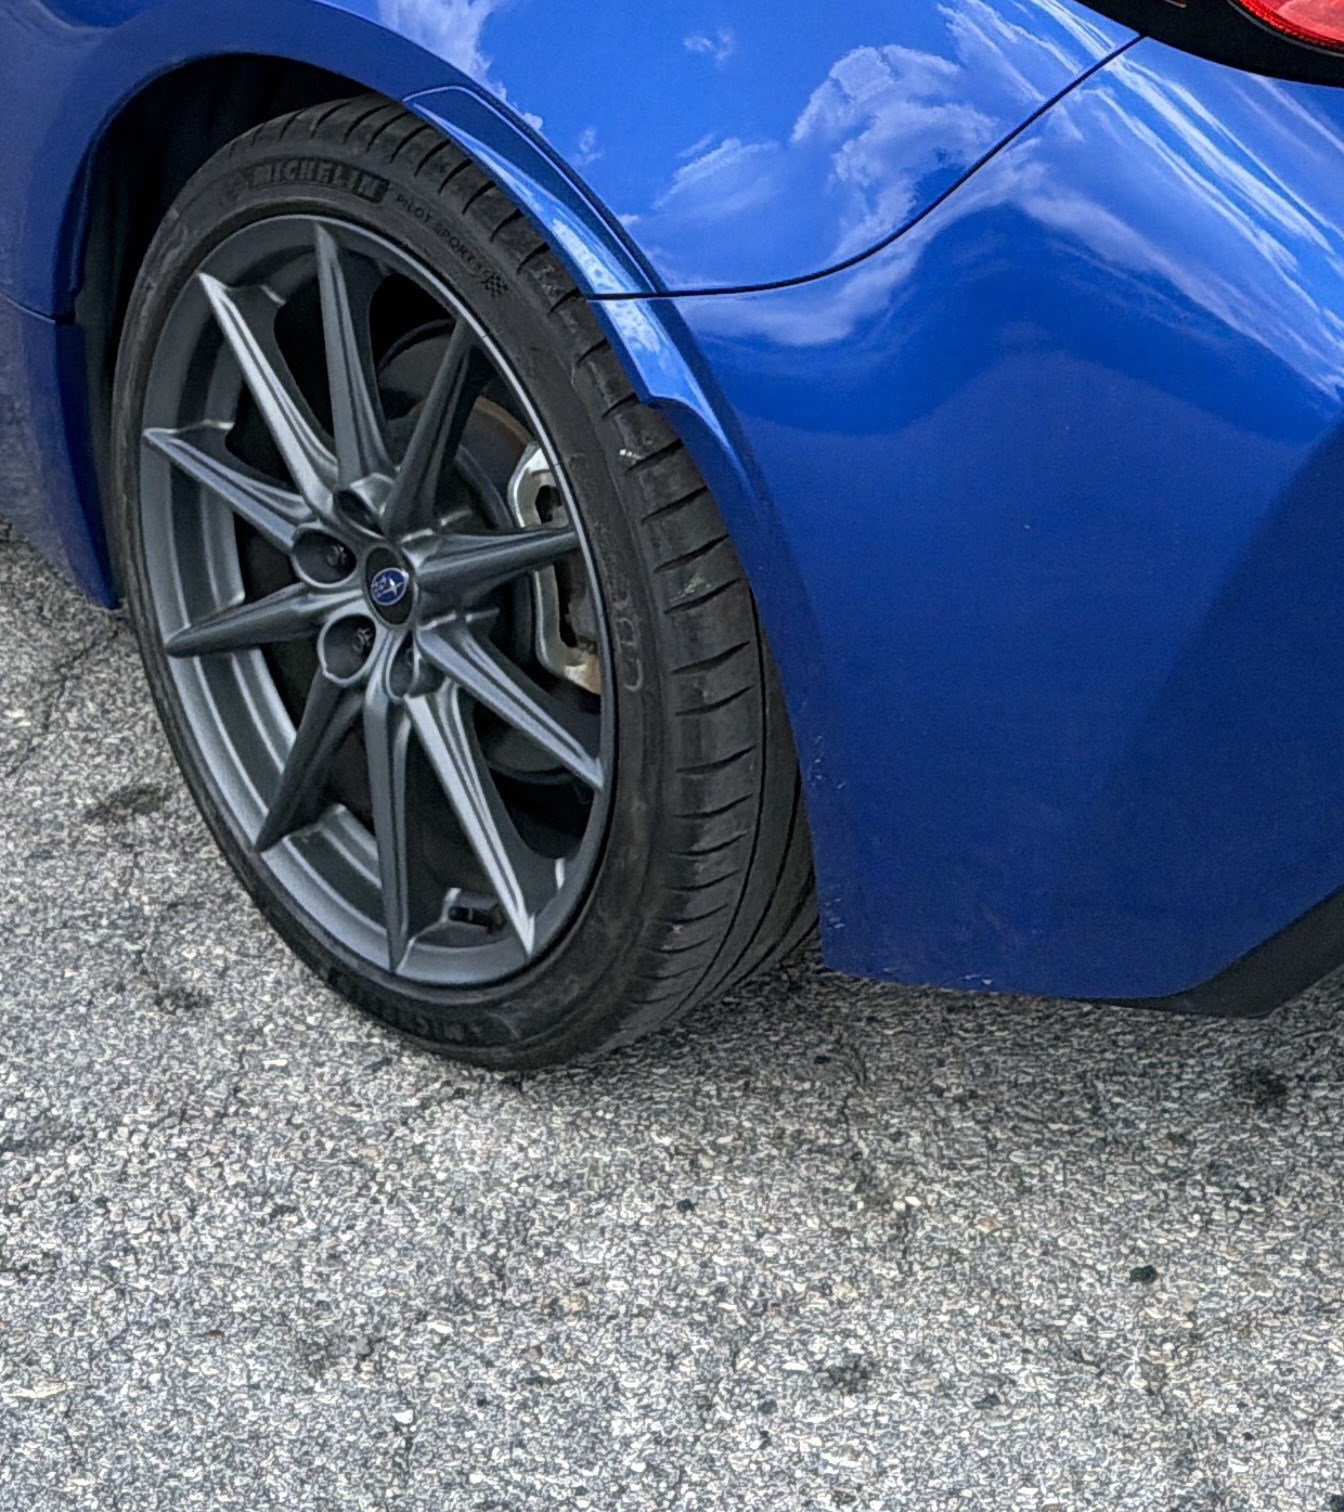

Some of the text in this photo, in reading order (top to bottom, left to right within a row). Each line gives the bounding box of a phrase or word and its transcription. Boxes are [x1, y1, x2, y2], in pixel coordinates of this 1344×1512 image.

[252, 159, 384, 200] MICHELIN
[396, 192, 476, 263] PILOT SPORT
